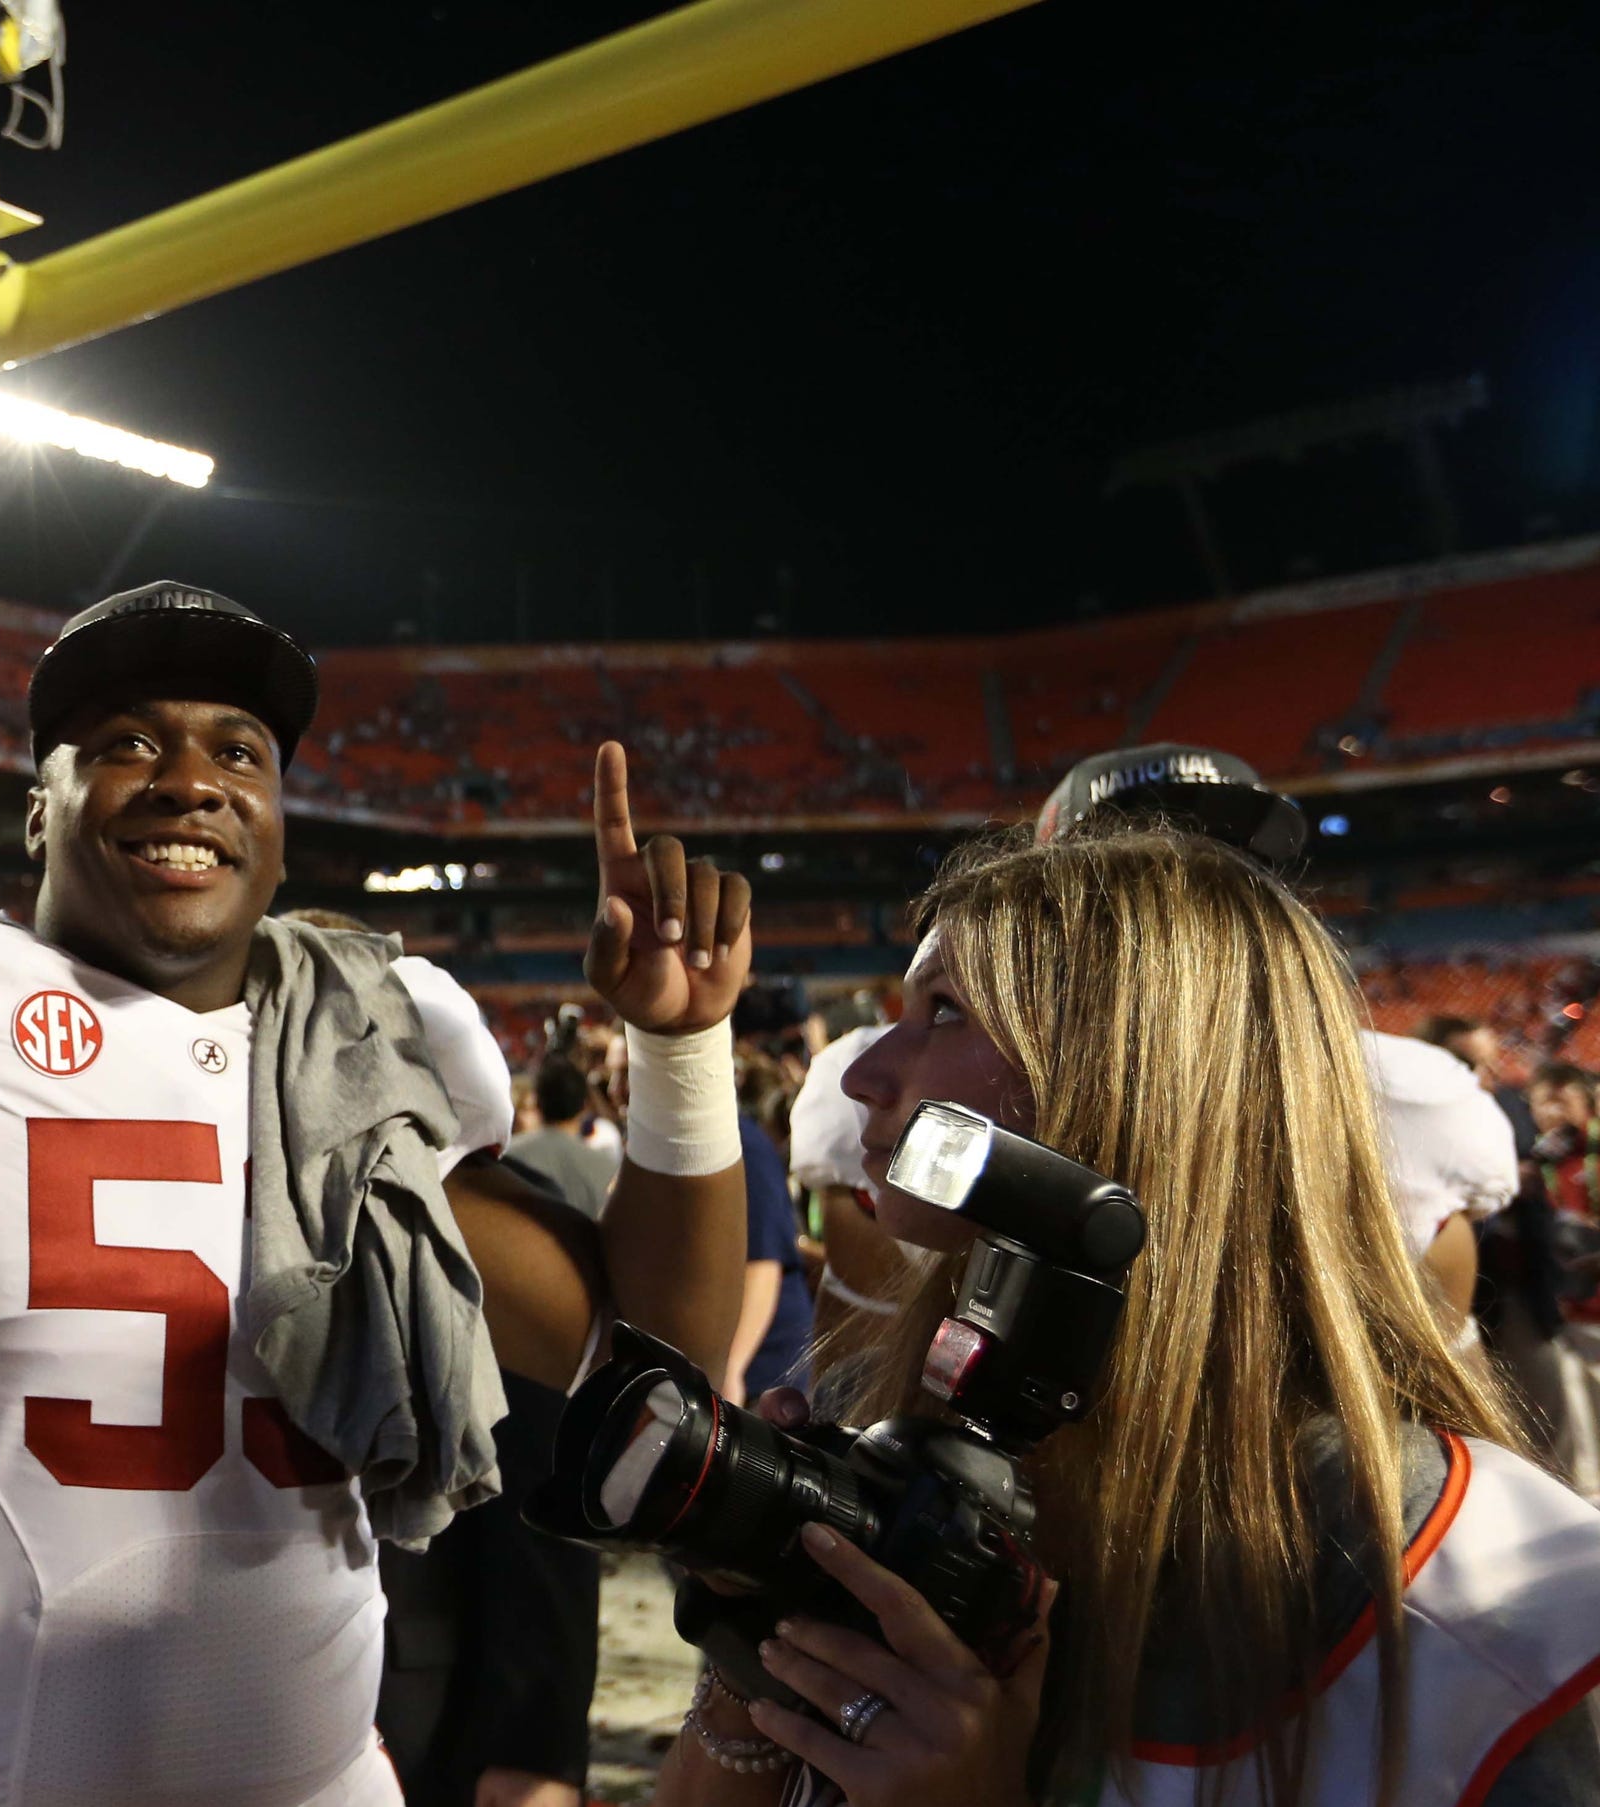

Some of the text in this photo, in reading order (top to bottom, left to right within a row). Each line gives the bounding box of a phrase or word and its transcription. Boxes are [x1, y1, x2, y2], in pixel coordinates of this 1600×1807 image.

[1090, 754, 1219, 804] NATIONAL
[19, 995, 97, 1072] SEC
[968, 1298, 993, 1318] Canon
[715, 1425, 726, 1452] CANON
[869, 1428, 904, 1451] Canon
